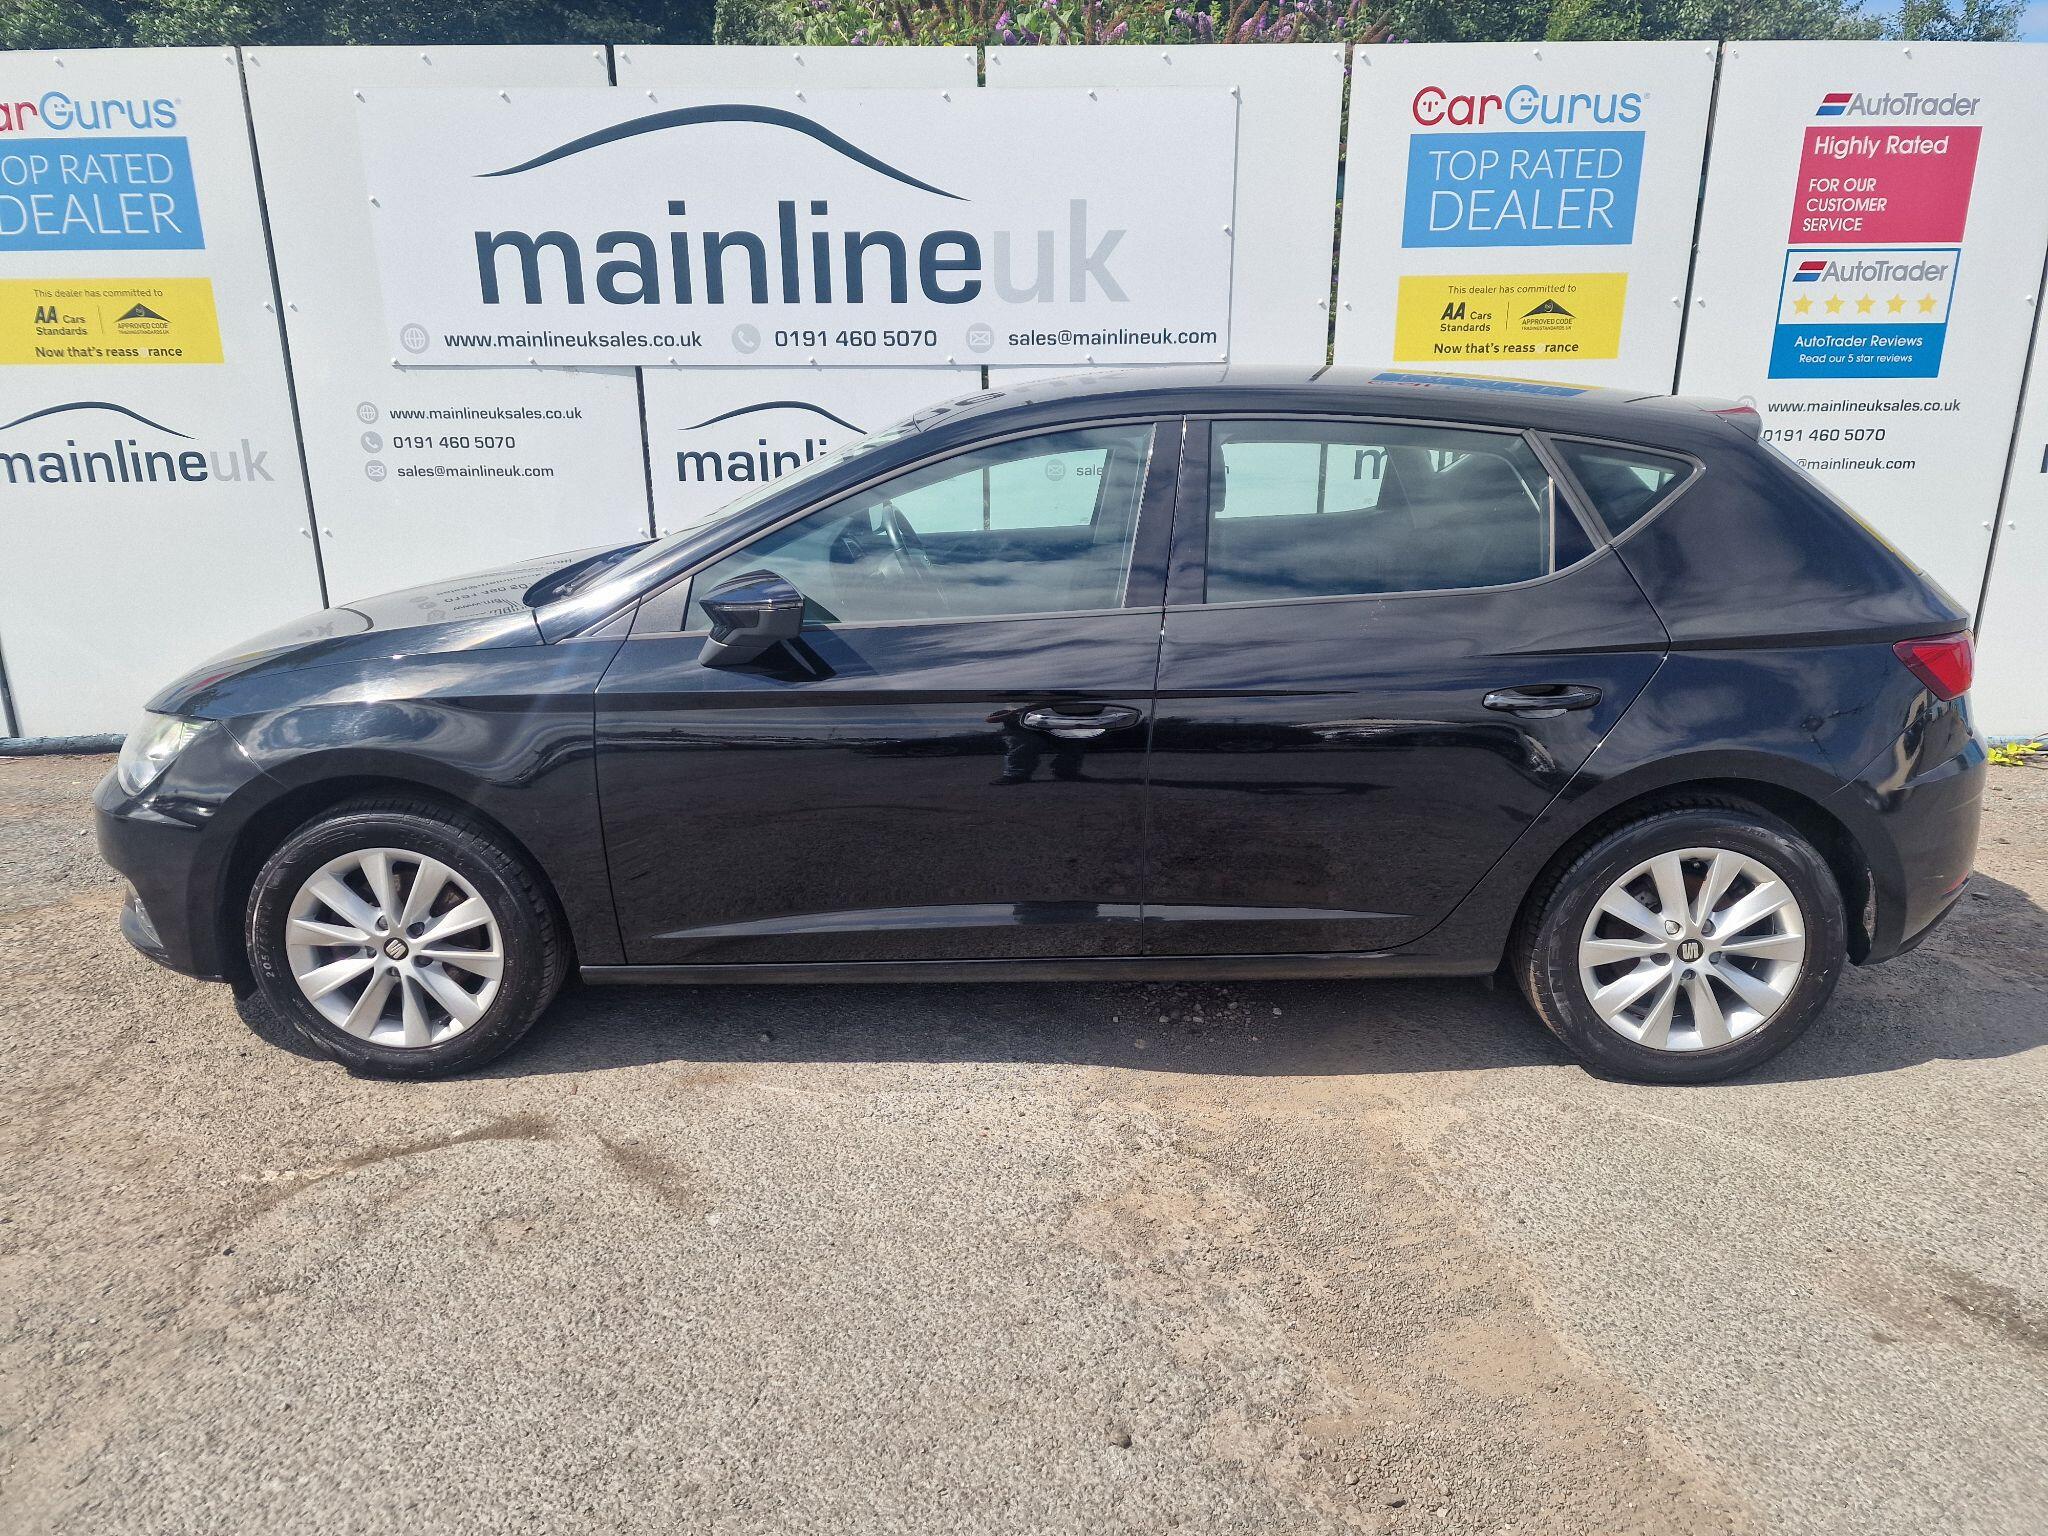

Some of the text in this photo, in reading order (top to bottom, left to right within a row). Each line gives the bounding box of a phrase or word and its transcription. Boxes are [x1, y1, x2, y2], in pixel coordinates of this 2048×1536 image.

[0, 91, 176, 131] arGurus
[1413, 85, 1642, 126] CarGurus
[1846, 92, 1980, 116] AutoTrader
[1814, 135, 1949, 159] Highly Rated
[2, 153, 173, 185] OP RATED
[1429, 148, 1623, 181] TOP RATED
[1809, 177, 1877, 193] FOR OUR
[1429, 187, 1614, 231] DEALER
[1806, 197, 1888, 213] CUSTOMER
[0, 192, 182, 235] DEALER
[1802, 217, 1863, 232] SERVICE
[475, 199, 1131, 305] mainlineuk
[1822, 260, 1949, 282] AutoTrader
[34, 288, 163, 298] This dealer has committed to
[1448, 284, 1577, 295] This dealer has committed to
[34, 305, 86, 324] AA Cars
[1440, 302, 1492, 320] AA Cars
[1440, 323, 1491, 333] Standards
[1521, 318, 1573, 326] APPROVED CODE
[36, 326, 88, 336] Standards
[774, 330, 937, 347] 0191 460 5070
[1008, 328, 1217, 346] sales@mainlineuk.com
[444, 331, 702, 348] www.mainlineuksales.co.uk
[1794, 334, 1923, 348] AutoTrader Reviews
[35, 347, 64, 358] Now
[67, 346, 103, 358] that's
[1433, 344, 1463, 354] Now
[1465, 342, 1500, 354] that's
[1799, 353, 1913, 363] Read our 5 star reviews
[389, 406, 582, 420] www.mainlineuksales.co.uk
[1768, 399, 1961, 412] www.mainlineuksales.co.uk
[393, 436, 516, 449] 0191 460 5070
[1763, 428, 1886, 442] 0191 460 5070
[397, 464, 554, 477] sales@mainlineuk.com
[1797, 458, 1916, 471] @mainlineuk.com
